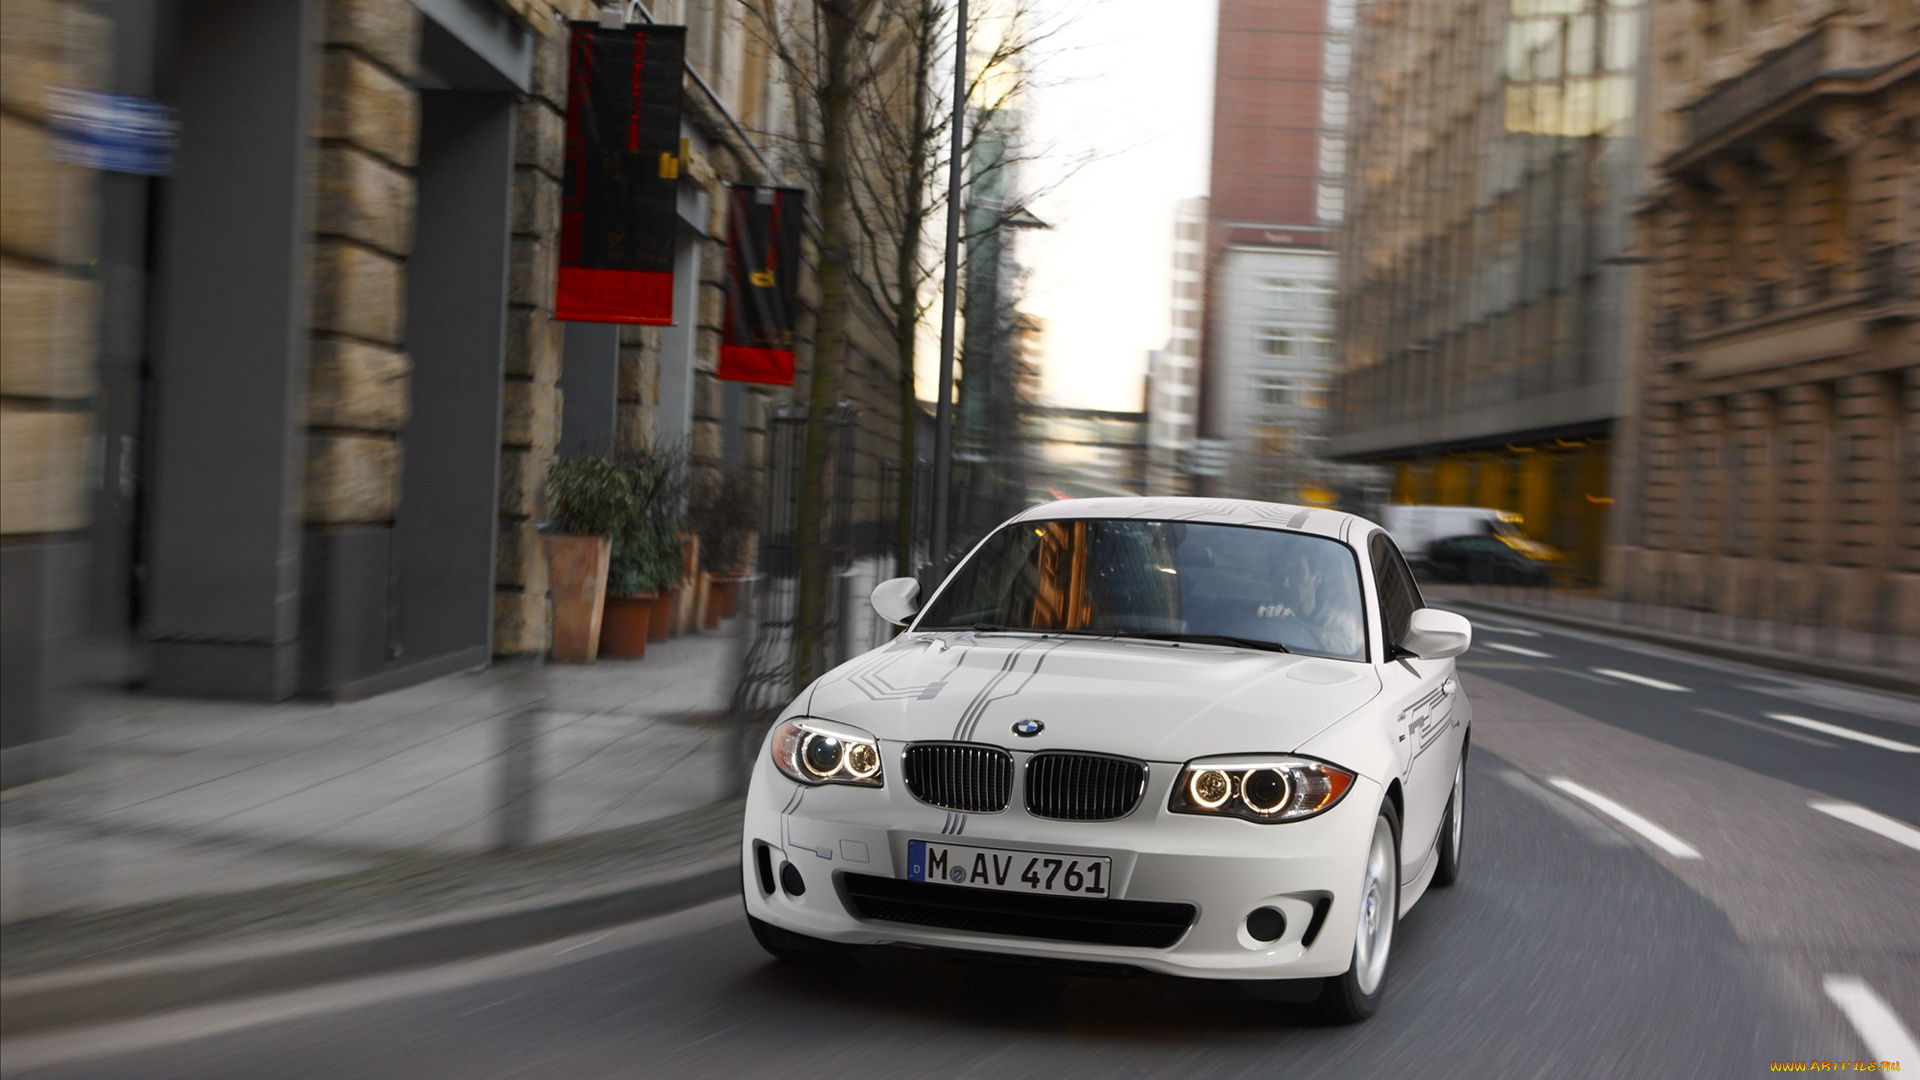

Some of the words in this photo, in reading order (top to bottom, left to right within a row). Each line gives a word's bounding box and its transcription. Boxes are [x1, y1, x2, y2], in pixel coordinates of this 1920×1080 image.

[913, 864, 921, 874] D
[928, 848, 948, 880] M
[970, 853, 1012, 885] AV
[1021, 857, 1105, 894] 4761
